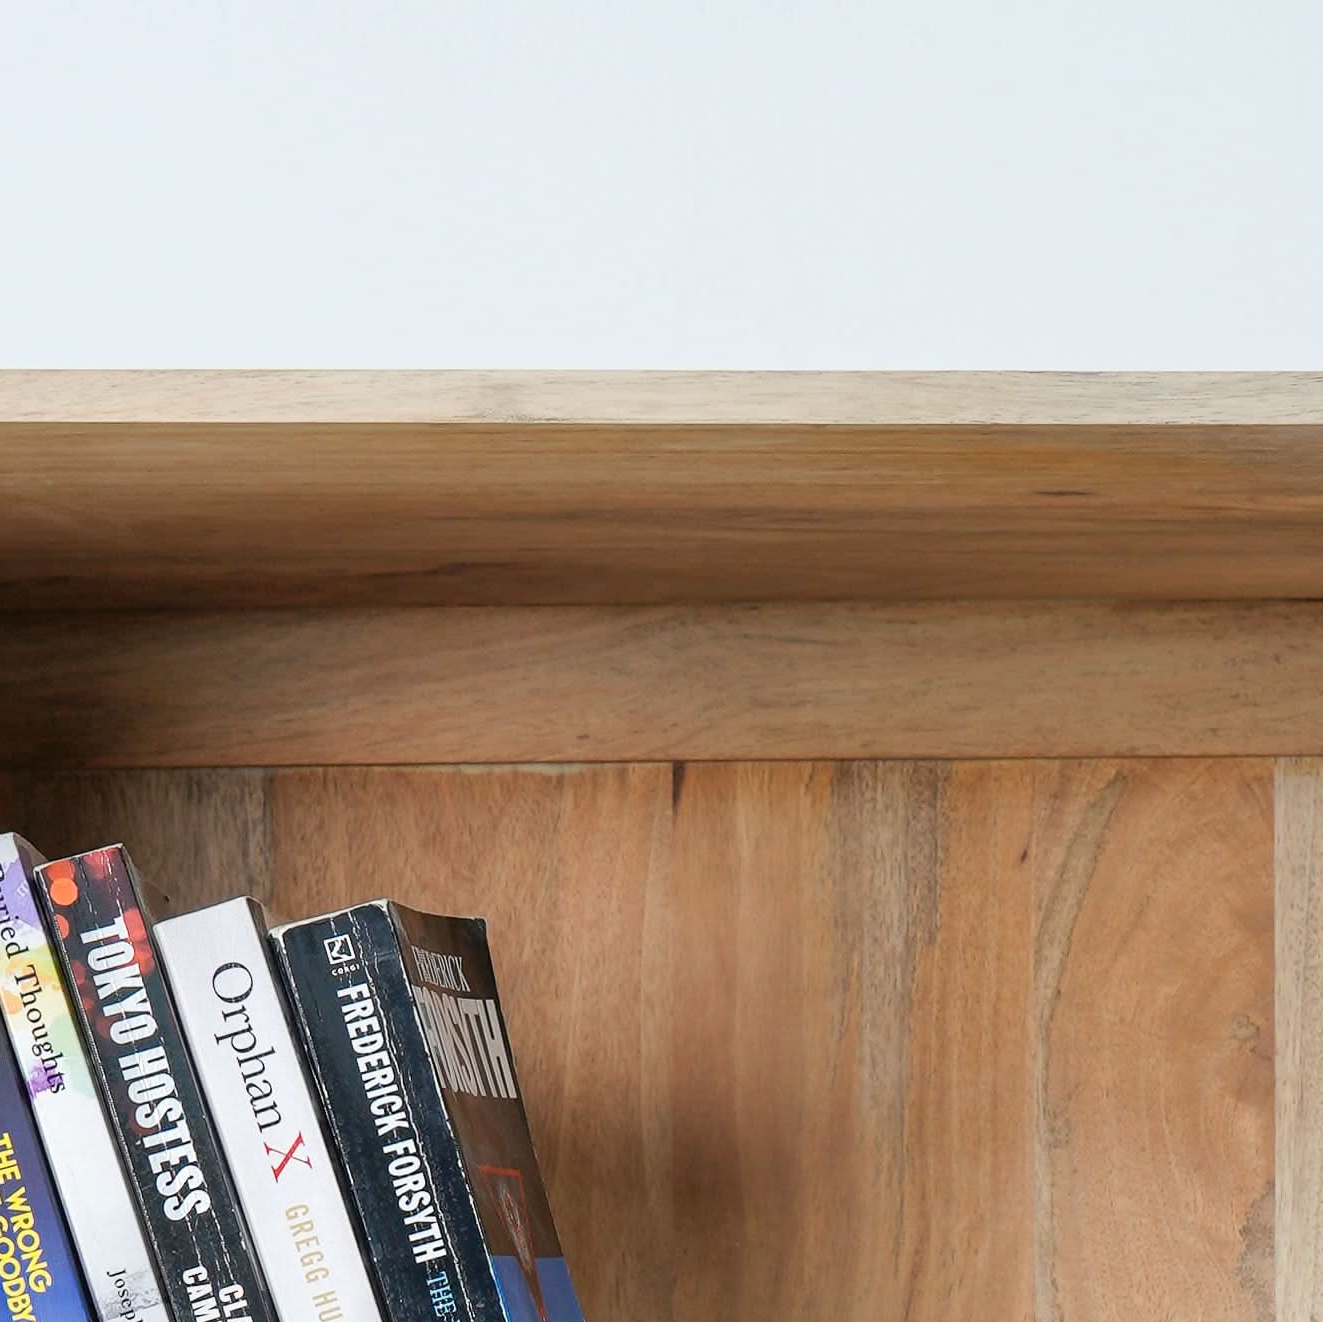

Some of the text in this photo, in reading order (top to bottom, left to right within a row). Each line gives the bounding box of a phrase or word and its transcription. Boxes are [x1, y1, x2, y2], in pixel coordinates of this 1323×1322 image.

[14, 964, 66, 1094] Thoughts
[331, 964, 360, 977] CORGI
[80, 916, 211, 1222] TOKYO HOSTESS
[212, 961, 313, 1183] Orphan X
[337, 982, 447, 1264] FREDERICK FORSYTH
[4, 1186, 53, 1294] WRONG
[285, 1203, 330, 1284] GREGG
[427, 1270, 457, 1318] THE
